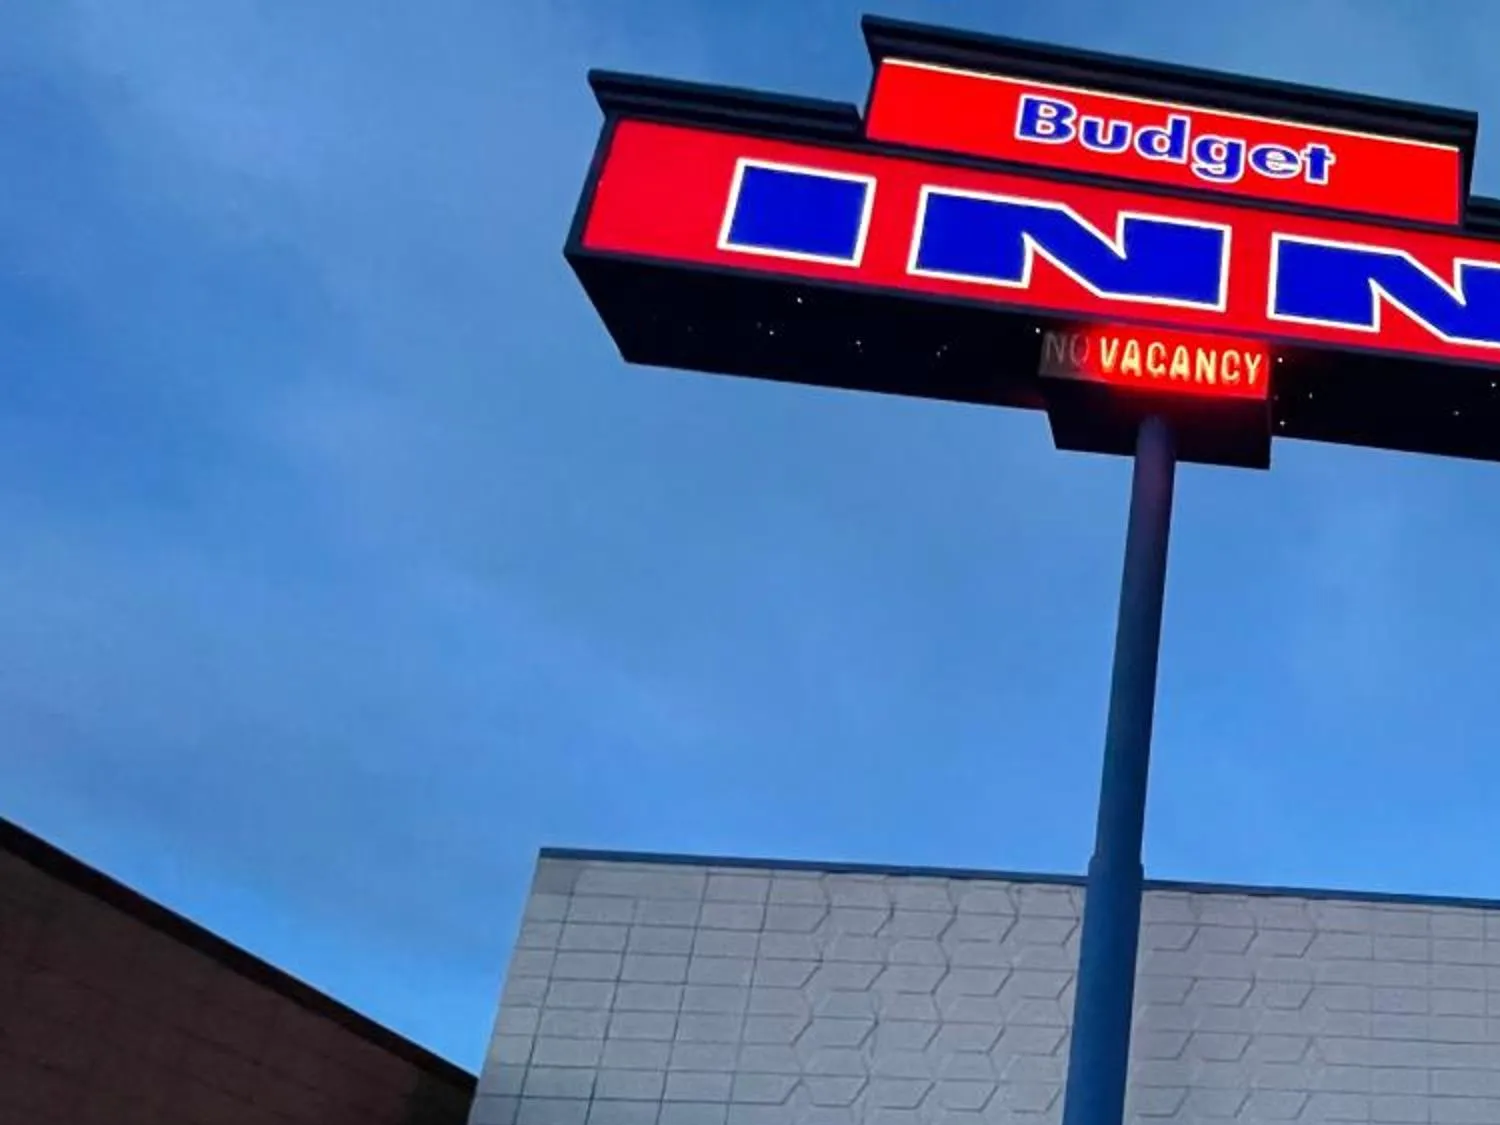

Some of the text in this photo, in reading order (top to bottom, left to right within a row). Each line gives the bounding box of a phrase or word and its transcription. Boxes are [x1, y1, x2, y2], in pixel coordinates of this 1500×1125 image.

[1014, 94, 1337, 185] Budget
[1043, 331, 1262, 385] NO VACANCY
